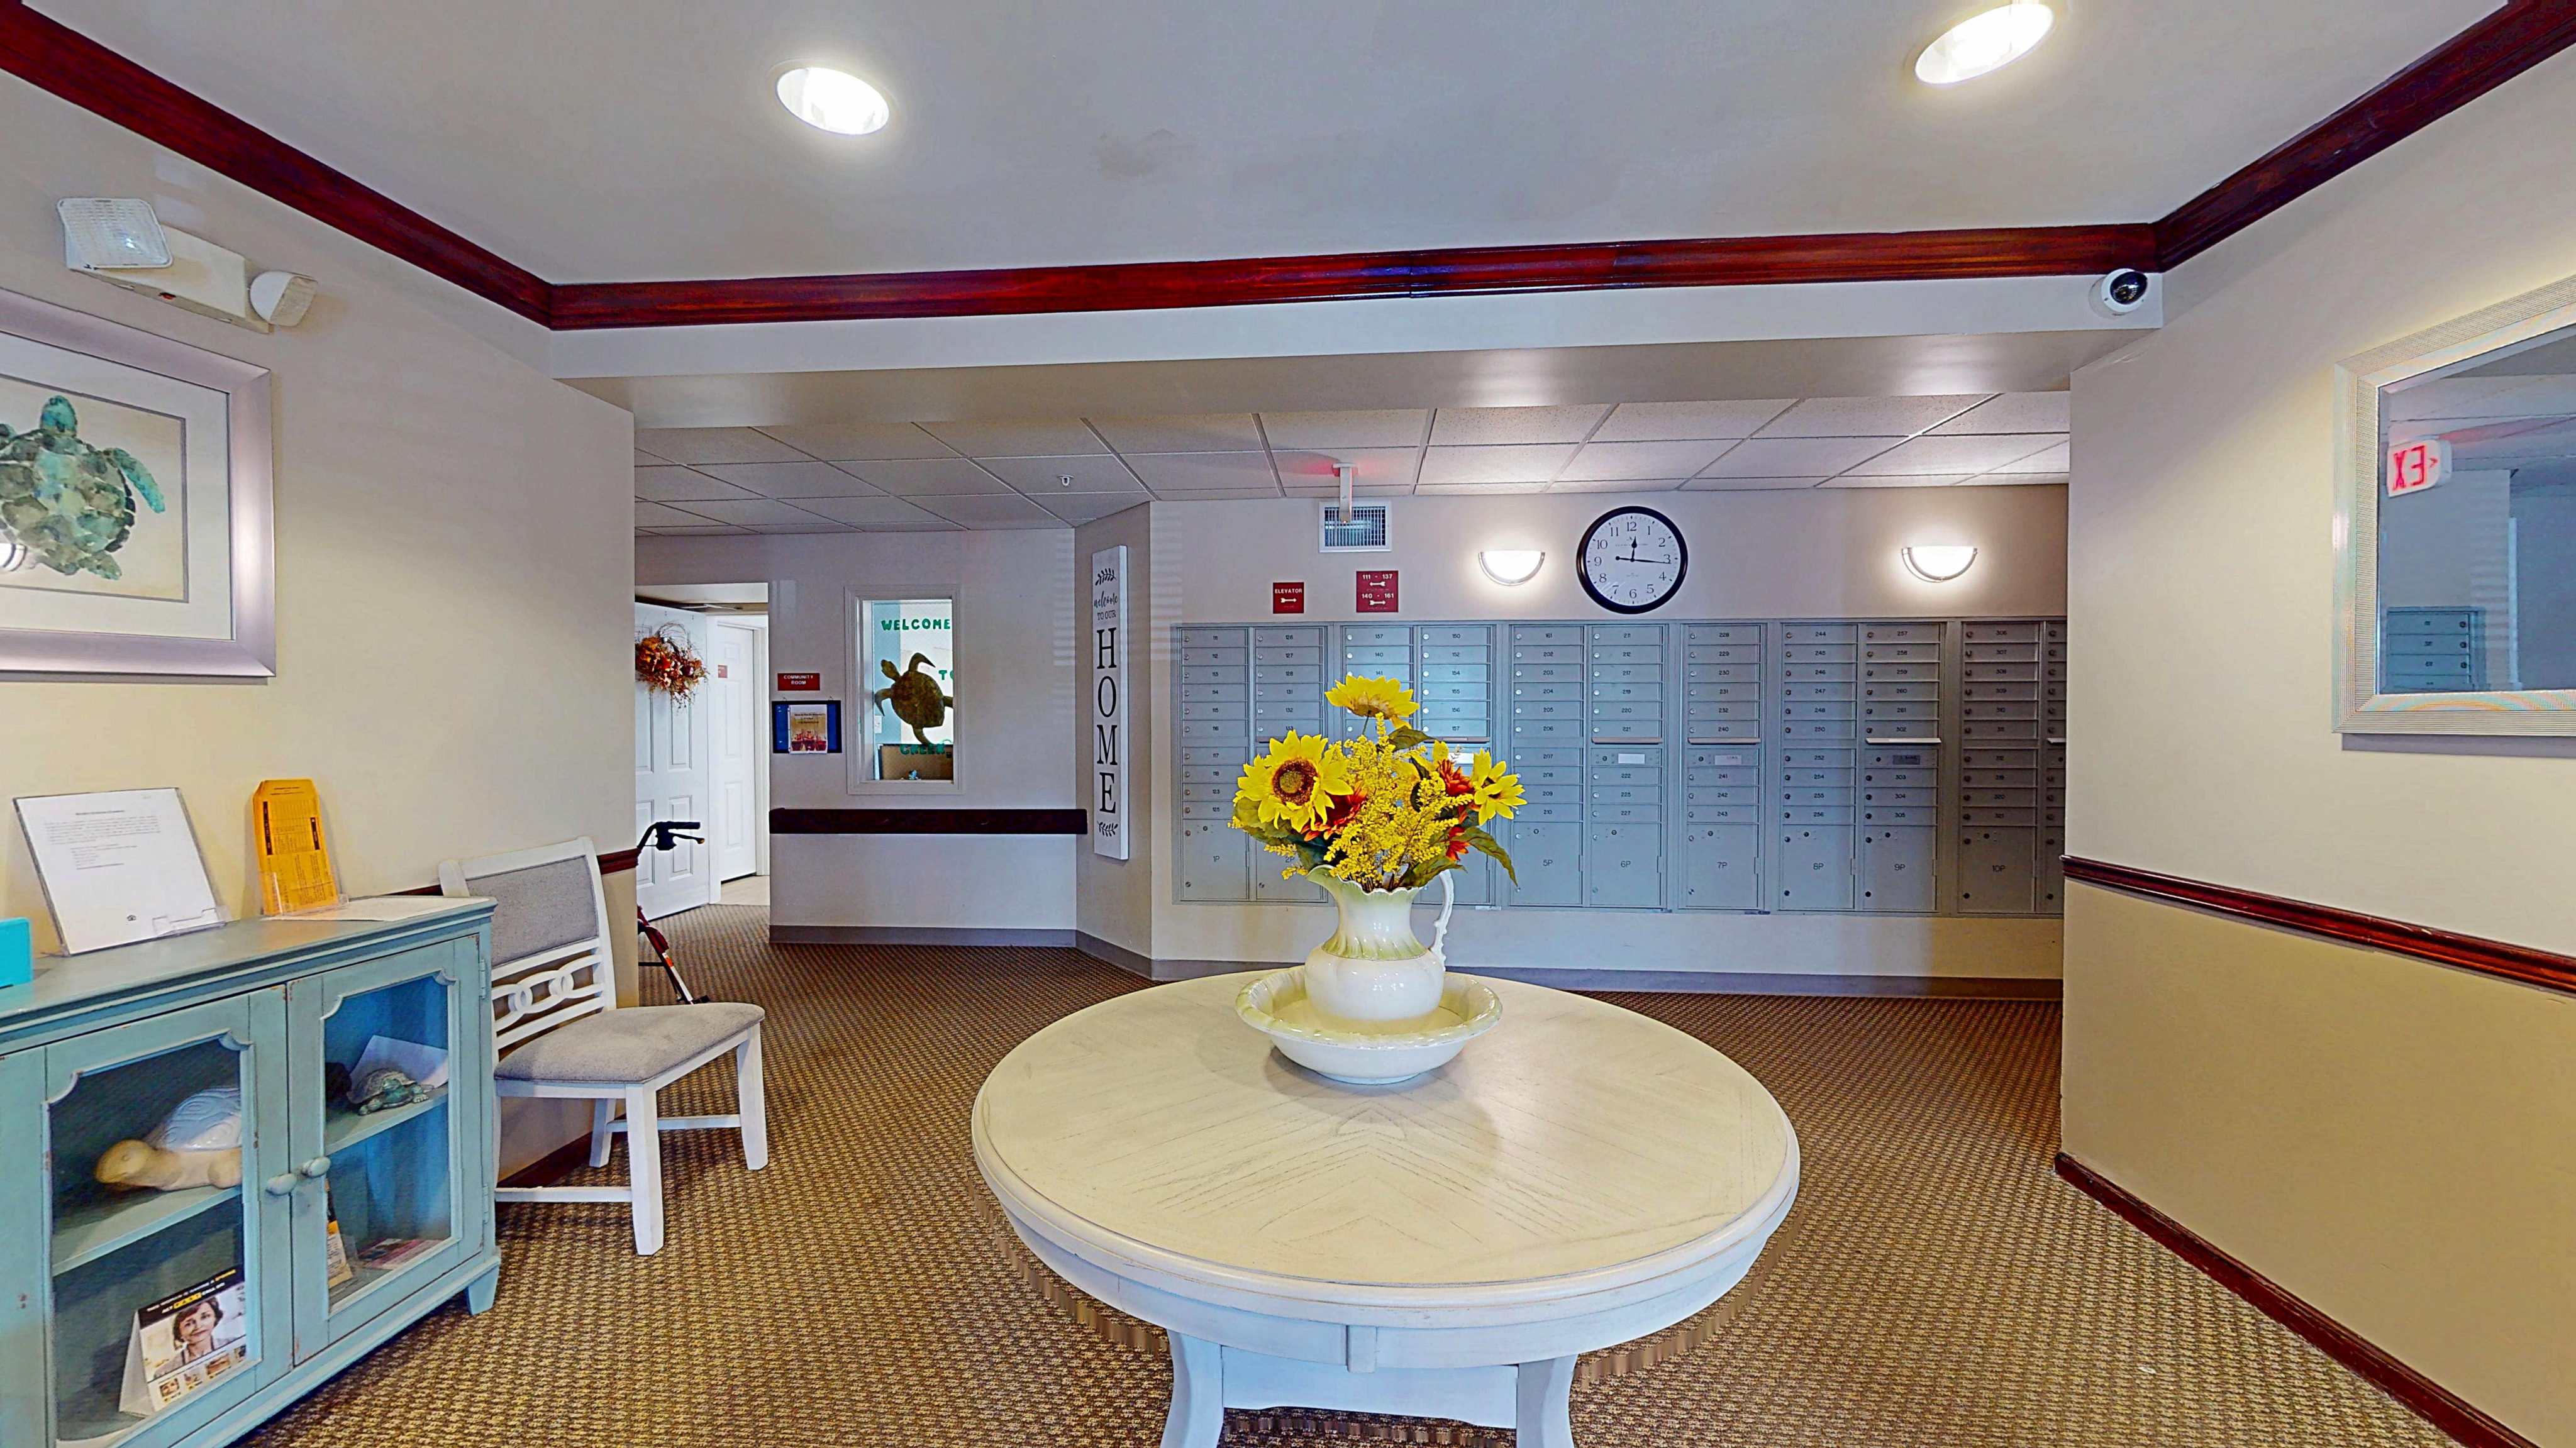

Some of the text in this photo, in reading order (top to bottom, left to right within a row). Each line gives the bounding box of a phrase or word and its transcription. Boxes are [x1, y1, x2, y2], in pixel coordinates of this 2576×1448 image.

[1626, 521, 1637, 532] 12
[1647, 526, 1651, 536] 1
[1611, 527, 1619, 537] 11
[1597, 539, 1608, 550] 10
[1658, 538, 1666, 548] 2
[1594, 556, 1602, 566] 9
[1663, 554, 1671, 564] 3
[1599, 573, 1607, 583] 8
[1658, 572, 1667, 581] 4
[1612, 585, 1619, 595] 7
[1629, 589, 1637, 599] 6
[1646, 584, 1655, 594] 5
[1094, 590, 1118, 609] welcome
[1097, 609, 1117, 621] TO OUR
[881, 618, 951, 631] WELCOME
[1096, 627, 1118, 814] HOME
[1813, 862, 1824, 870] 8P
[1894, 863, 1906, 871] 9P
[1992, 865, 2006, 873] 10P
